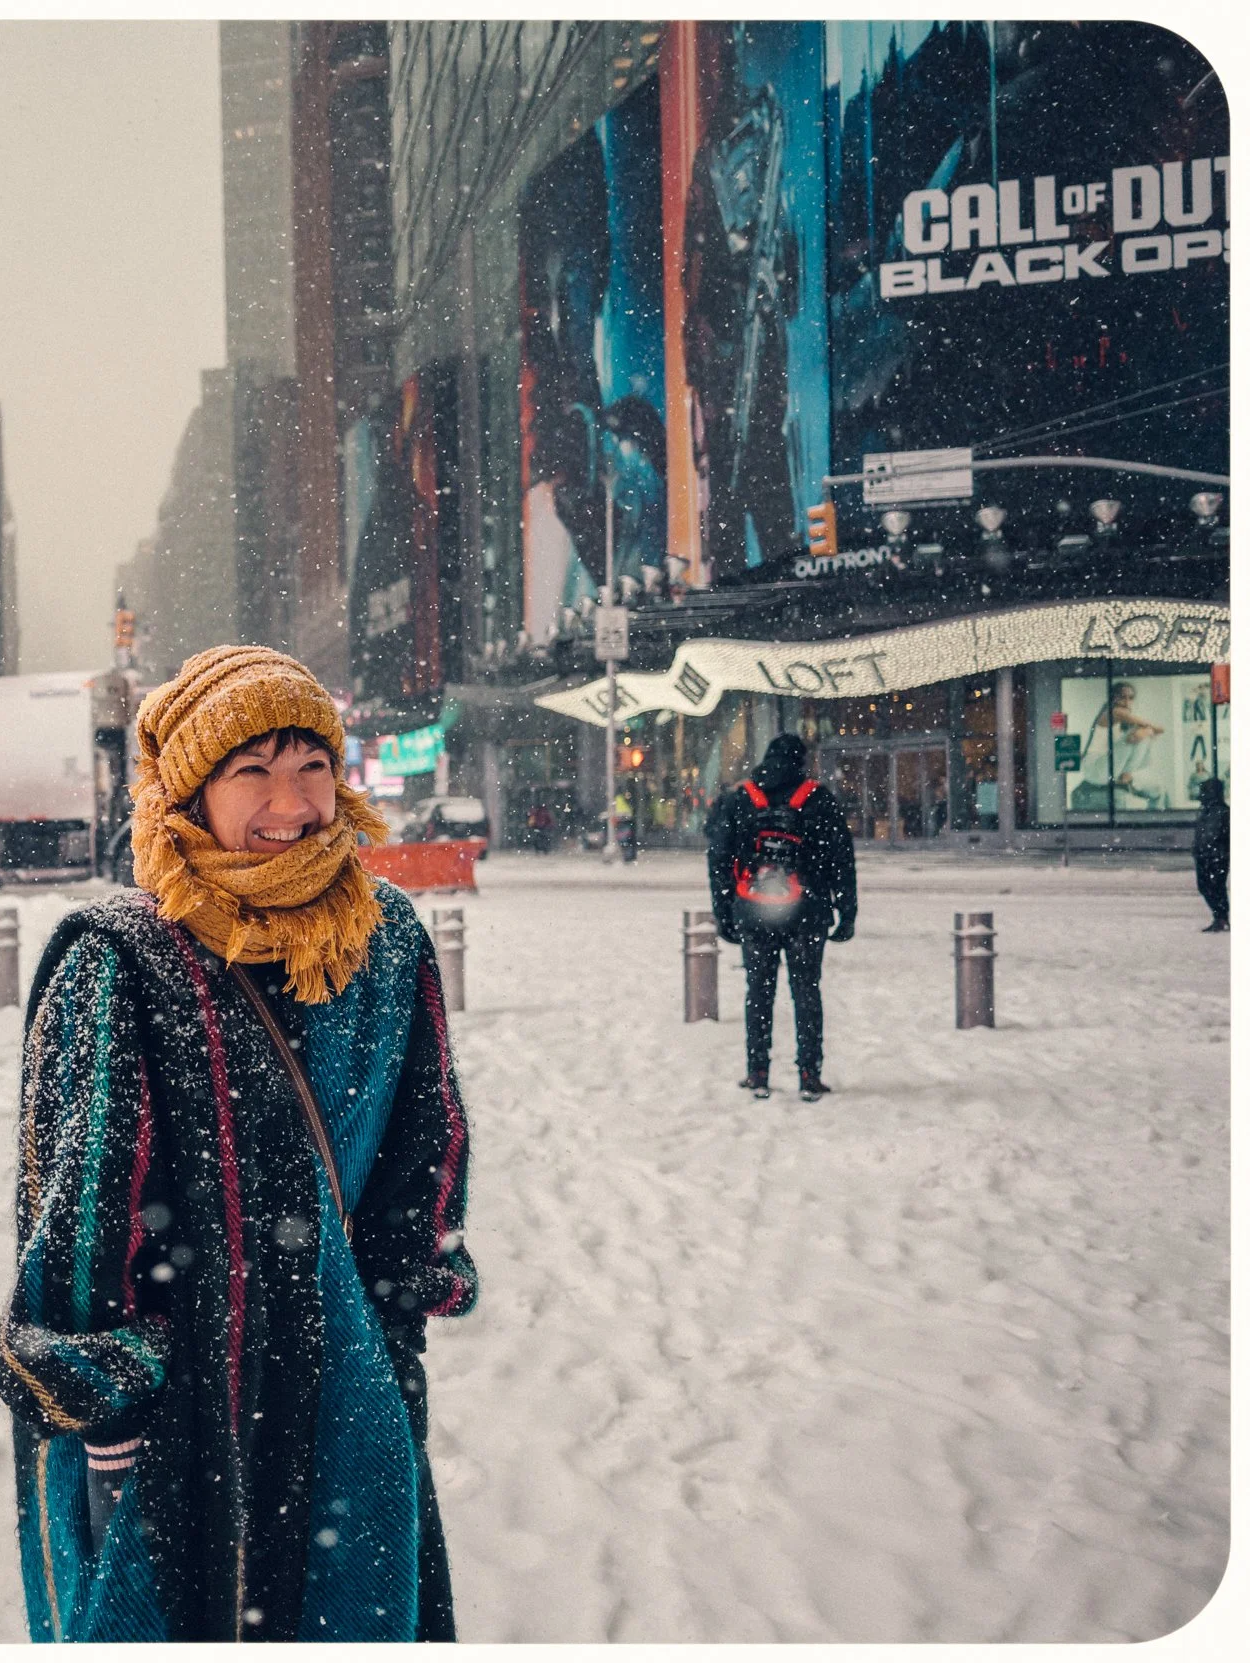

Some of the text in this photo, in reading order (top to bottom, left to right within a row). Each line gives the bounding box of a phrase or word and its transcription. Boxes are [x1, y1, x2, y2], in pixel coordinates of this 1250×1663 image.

[903, 175, 1070, 256] CALL
[1063, 183, 1107, 215] OF
[879, 230, 1230, 299] BLACK OP
[757, 652, 886, 693] LOFT
